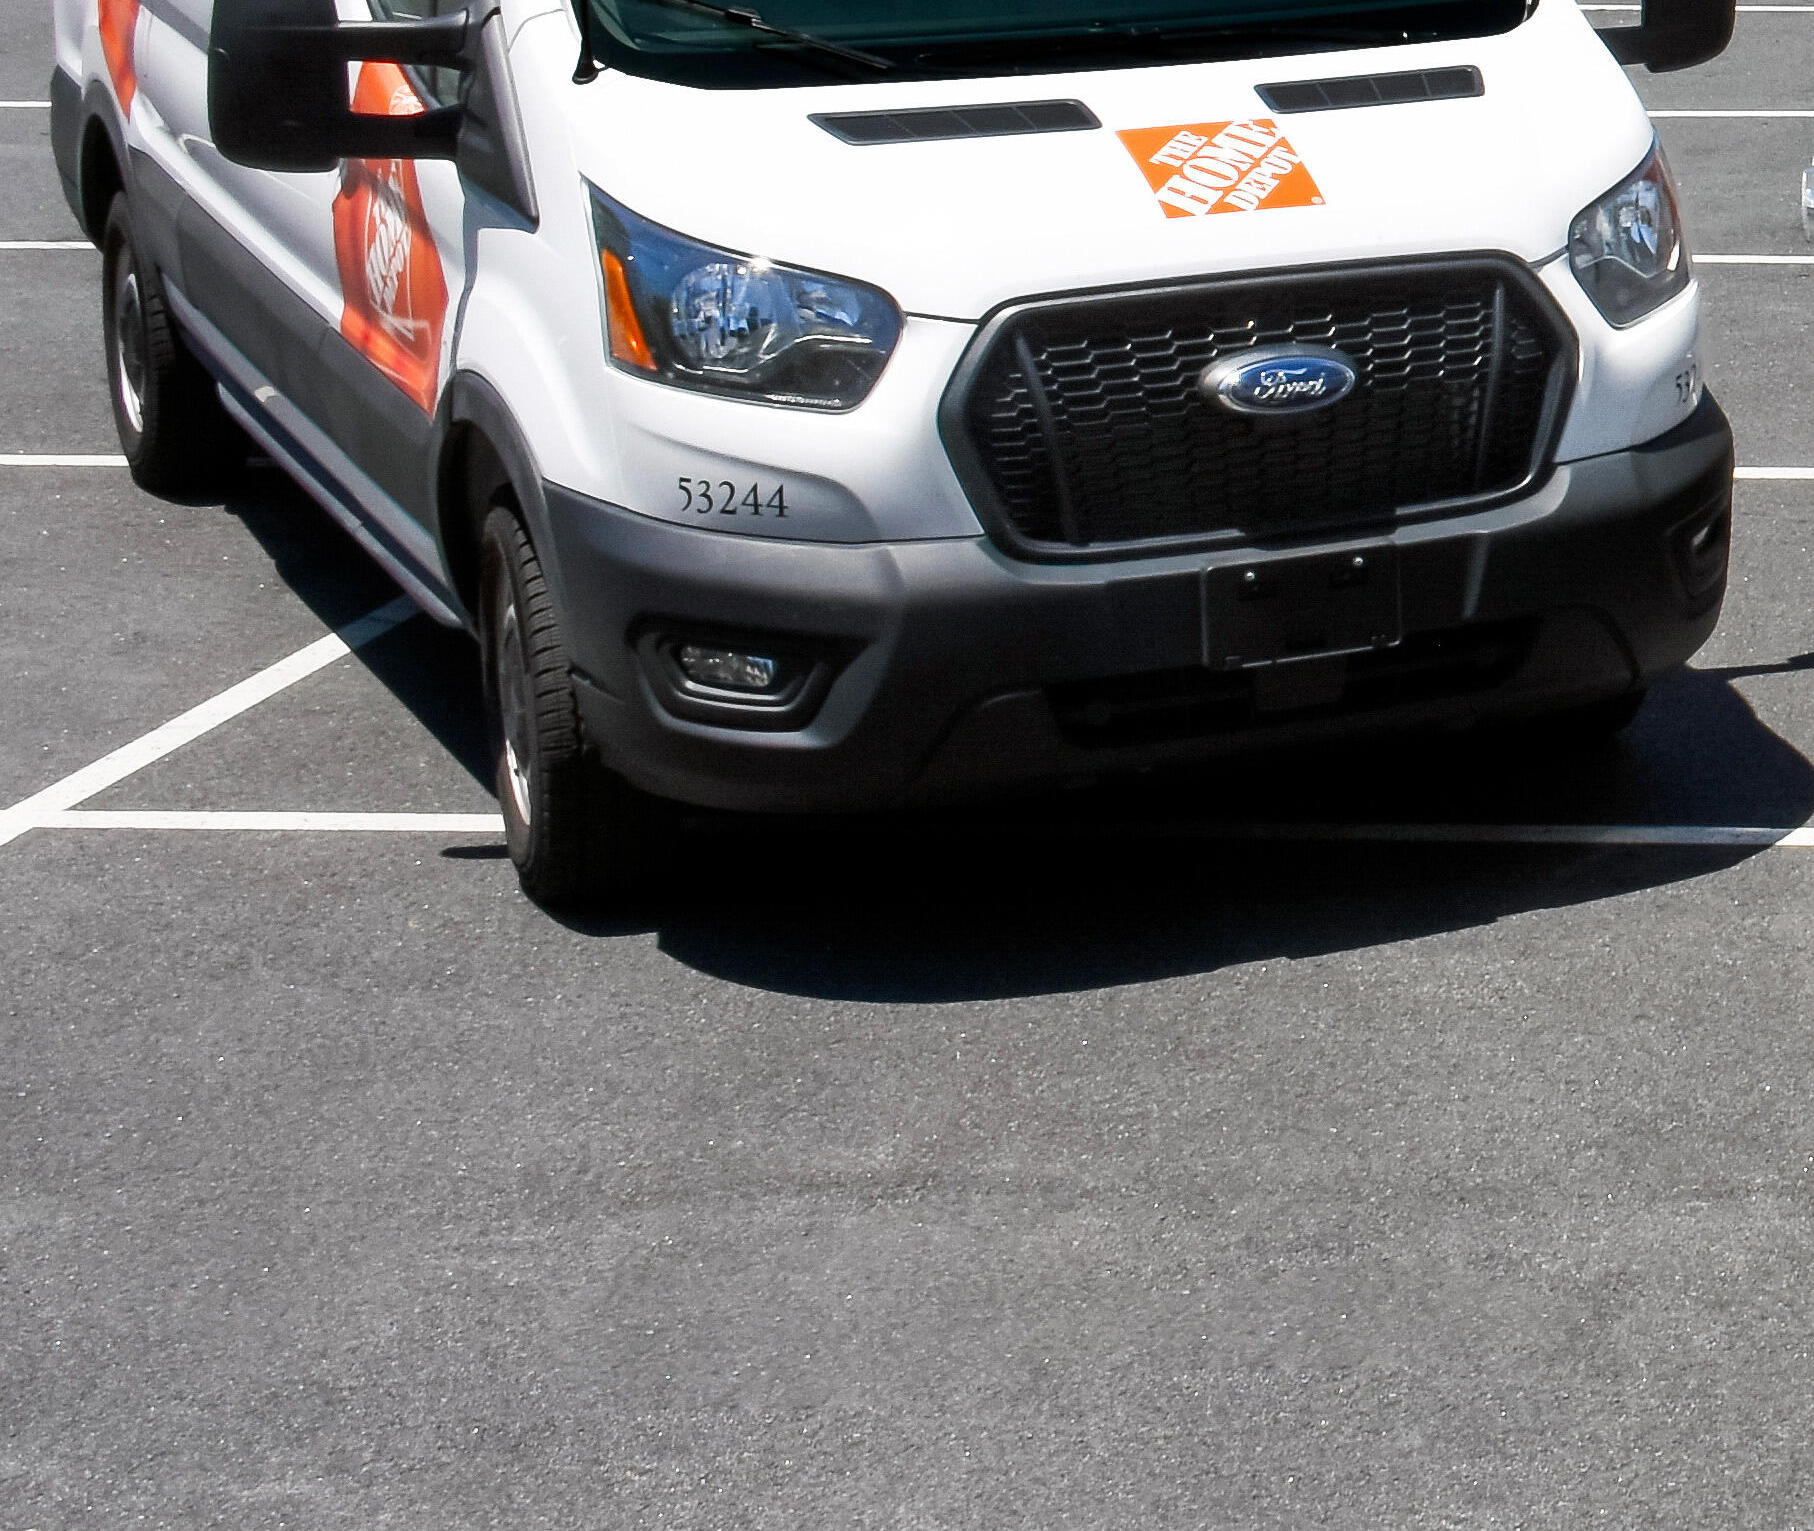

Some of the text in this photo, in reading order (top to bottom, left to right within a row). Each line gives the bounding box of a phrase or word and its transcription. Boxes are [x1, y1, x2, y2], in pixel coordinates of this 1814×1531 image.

[1149, 130, 1209, 167] THE
[1155, 119, 1283, 216] HOME
[1224, 145, 1302, 211] DEPOT
[1254, 368, 1328, 400] Ford
[678, 476, 789, 518] 53244
